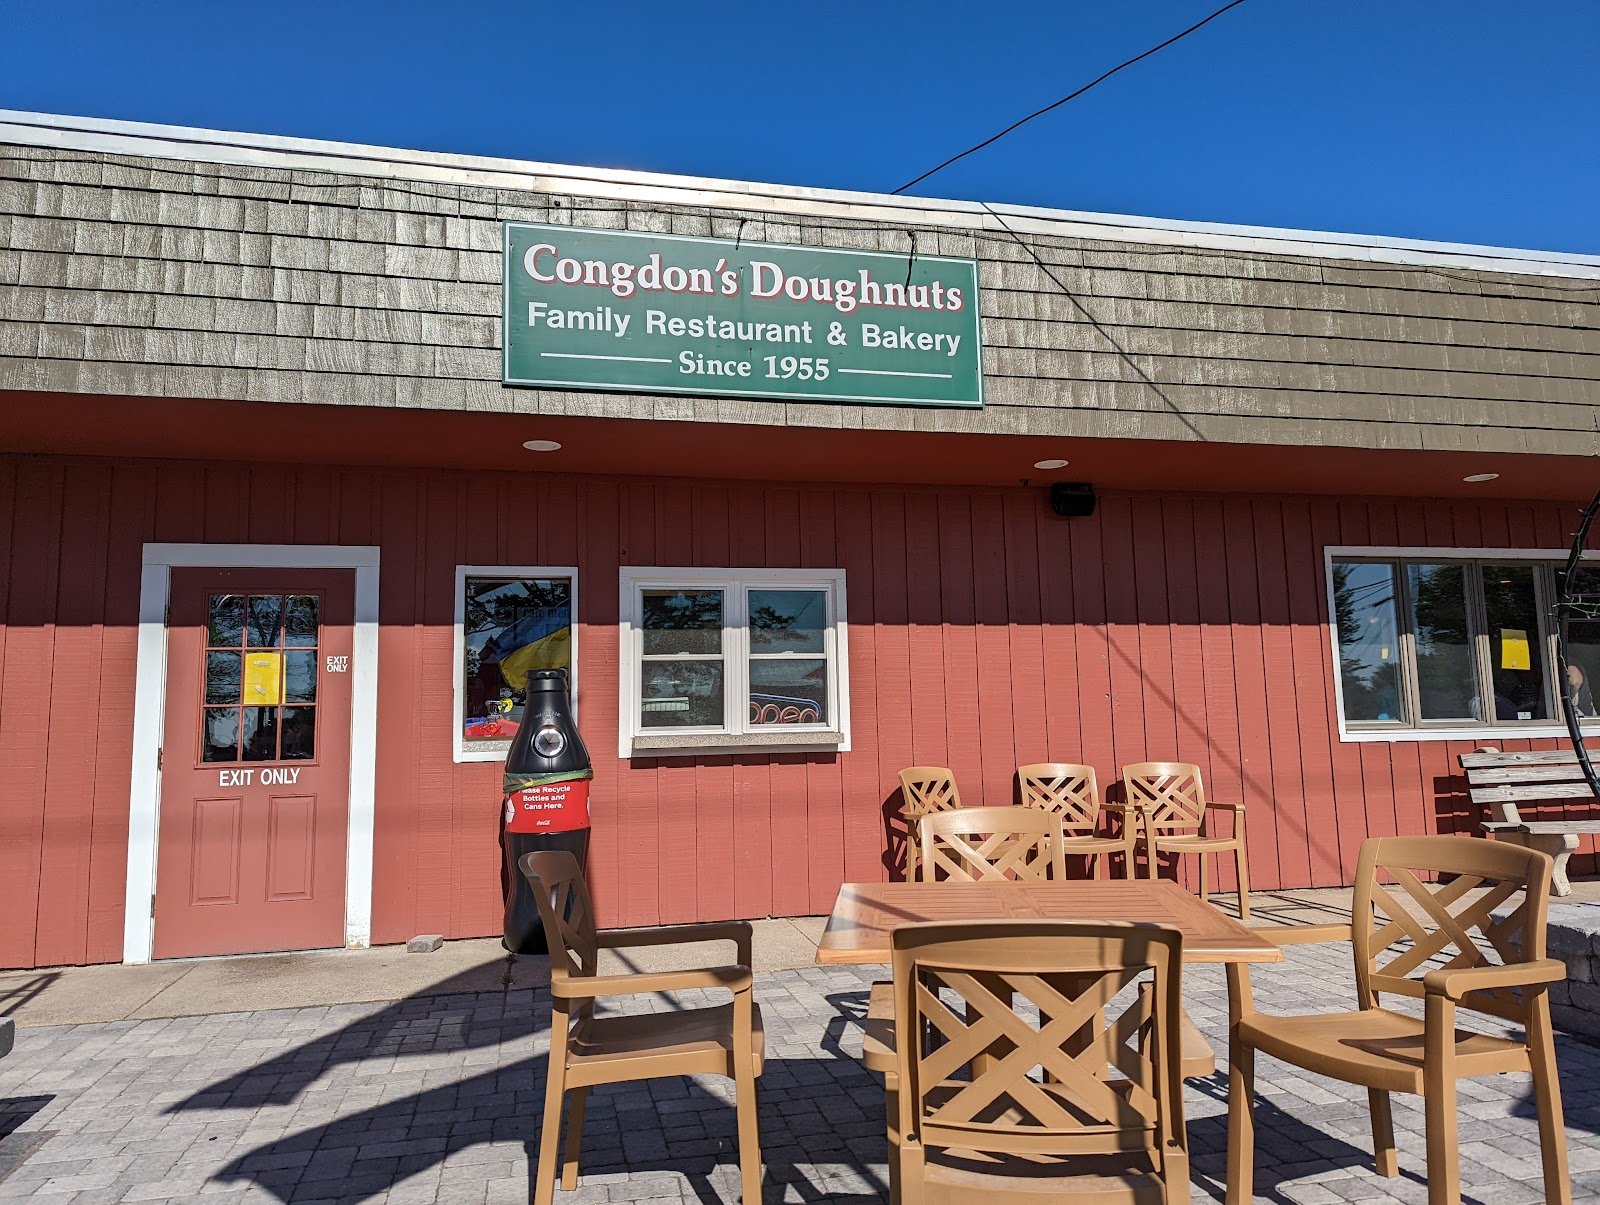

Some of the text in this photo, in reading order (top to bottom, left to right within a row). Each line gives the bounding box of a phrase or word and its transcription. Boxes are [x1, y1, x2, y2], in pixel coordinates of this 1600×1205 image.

[523, 243, 963, 314] Congdon's Doughnuts
[528, 301, 961, 357] Family Restaurant & Bakery
[678, 350, 830, 381] Since 1955
[326, 655, 349, 664] EXIT
[326, 664, 349, 673] ONLY
[219, 767, 301, 787] EXIT ONLY
[542, 785, 571, 794] Recycle
[550, 793, 566, 801] and
[543, 801, 564, 810] Here.
